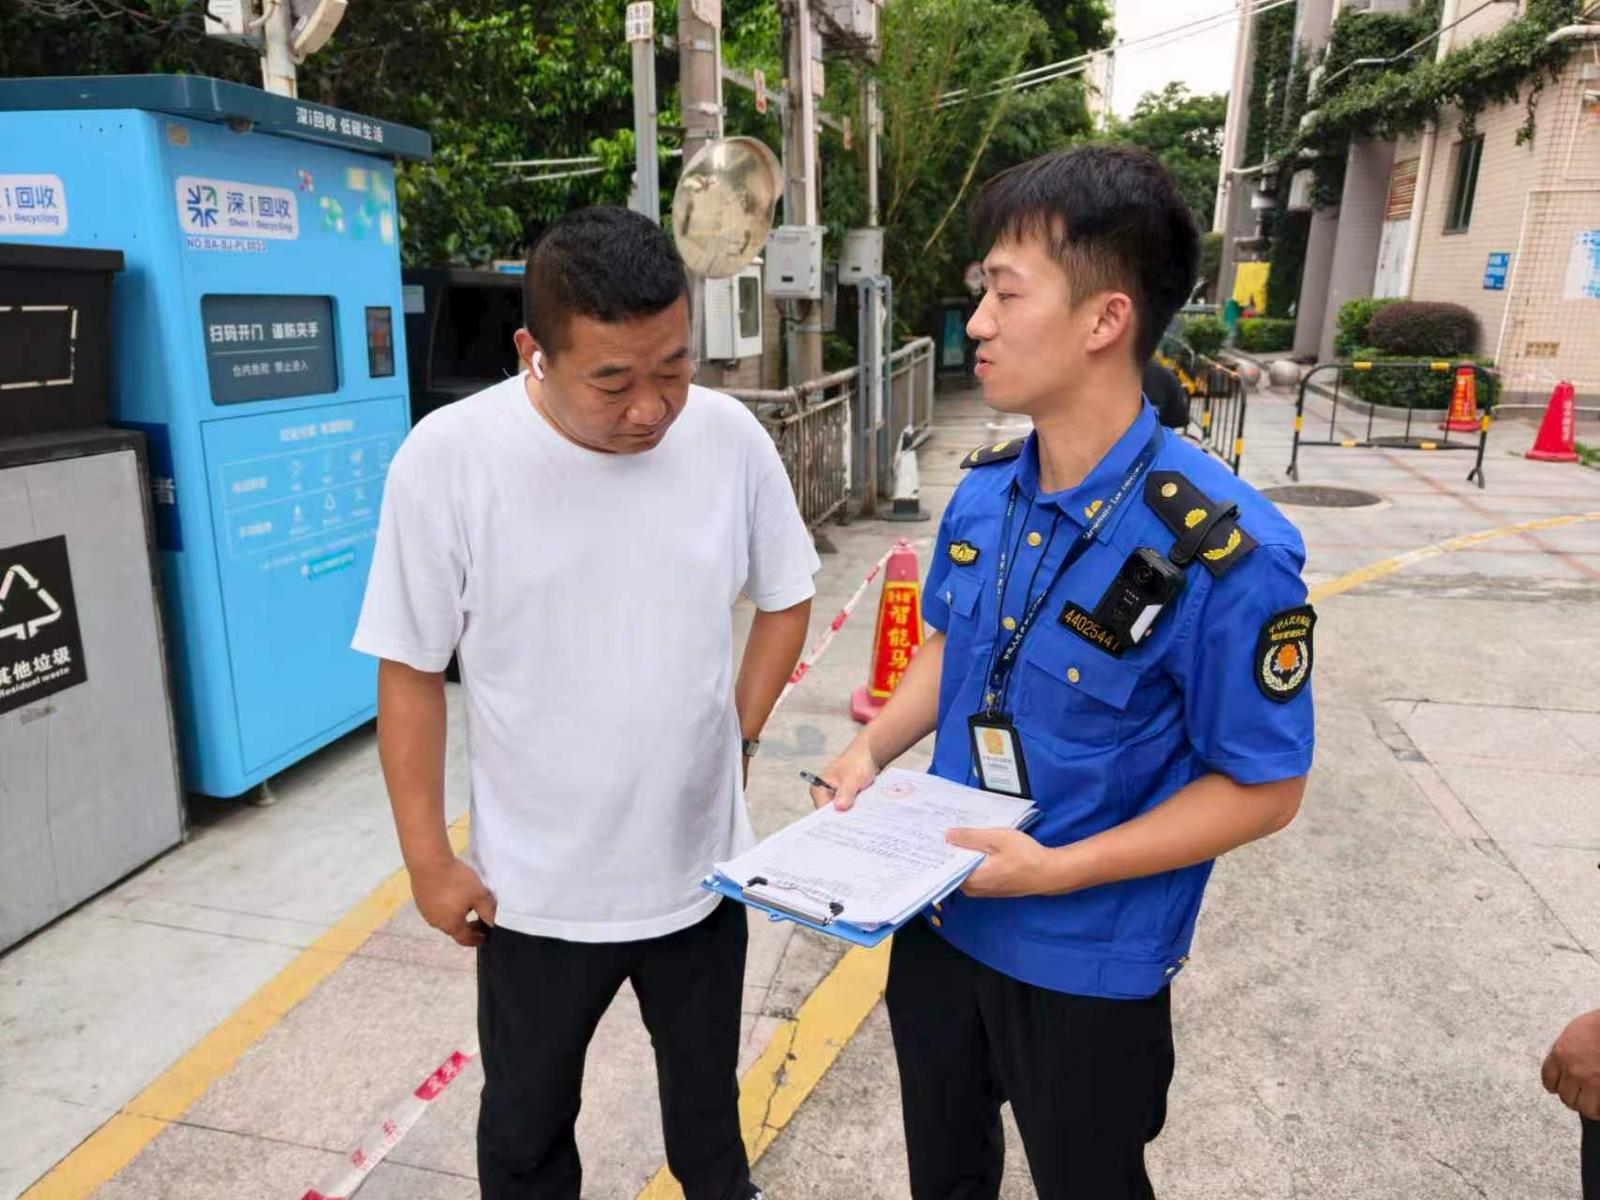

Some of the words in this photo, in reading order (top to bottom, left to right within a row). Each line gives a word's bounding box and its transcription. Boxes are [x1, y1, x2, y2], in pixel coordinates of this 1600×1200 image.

[209, 323, 264, 343] 扫码开门
[272, 320, 319, 339] 谨防夹手
[0, 645, 72, 688] 其他垃圾
[41, 666, 71, 682] waste
